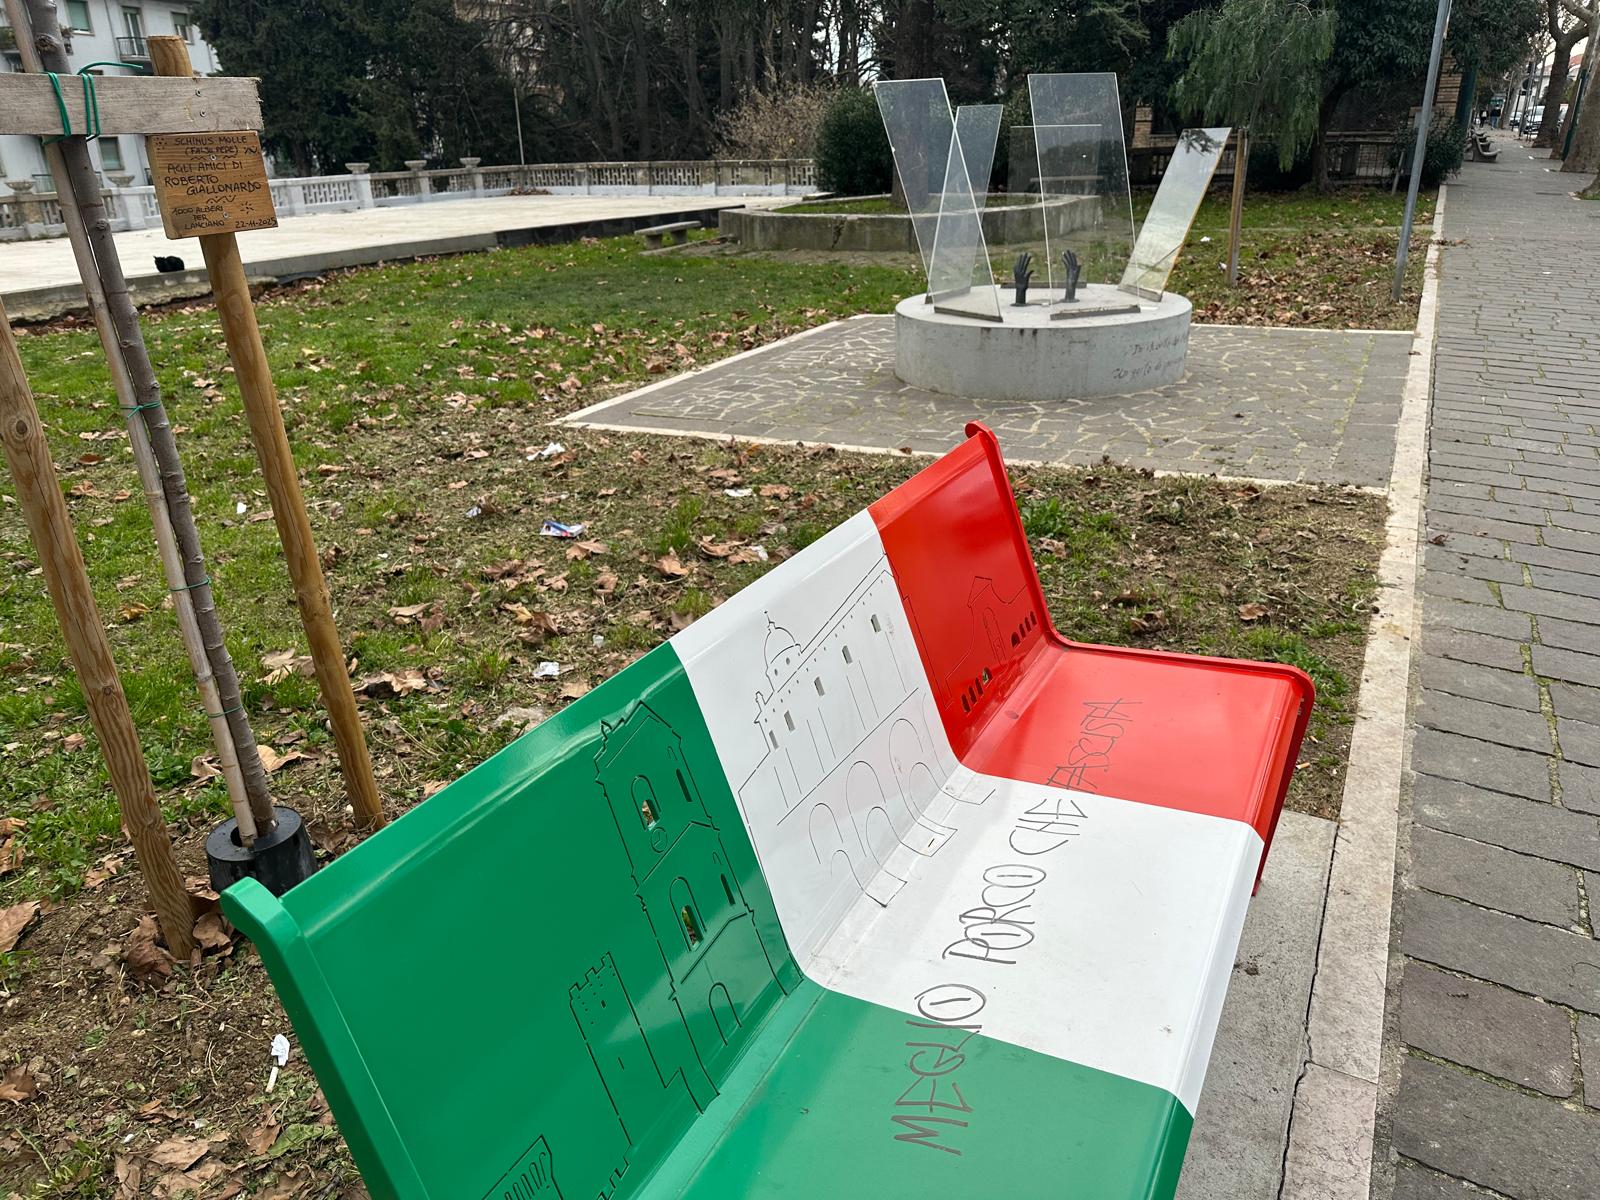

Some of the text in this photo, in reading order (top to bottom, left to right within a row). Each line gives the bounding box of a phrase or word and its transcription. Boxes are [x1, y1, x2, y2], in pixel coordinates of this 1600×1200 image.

[174, 135, 247, 146] SCHINUS MOLLE
[198, 161, 227, 172] AMICI
[232, 160, 243, 170] DI
[164, 174, 219, 188] ROBERTO
[186, 180, 262, 196] GIALLONARDO
[171, 205, 224, 216] 1000 ALBERI
[192, 214, 208, 222] PER
[184, 219, 225, 230] LANCIANO
[890, 697, 1144, 1157] MEGLIO PORCO CHE FASCISTA
